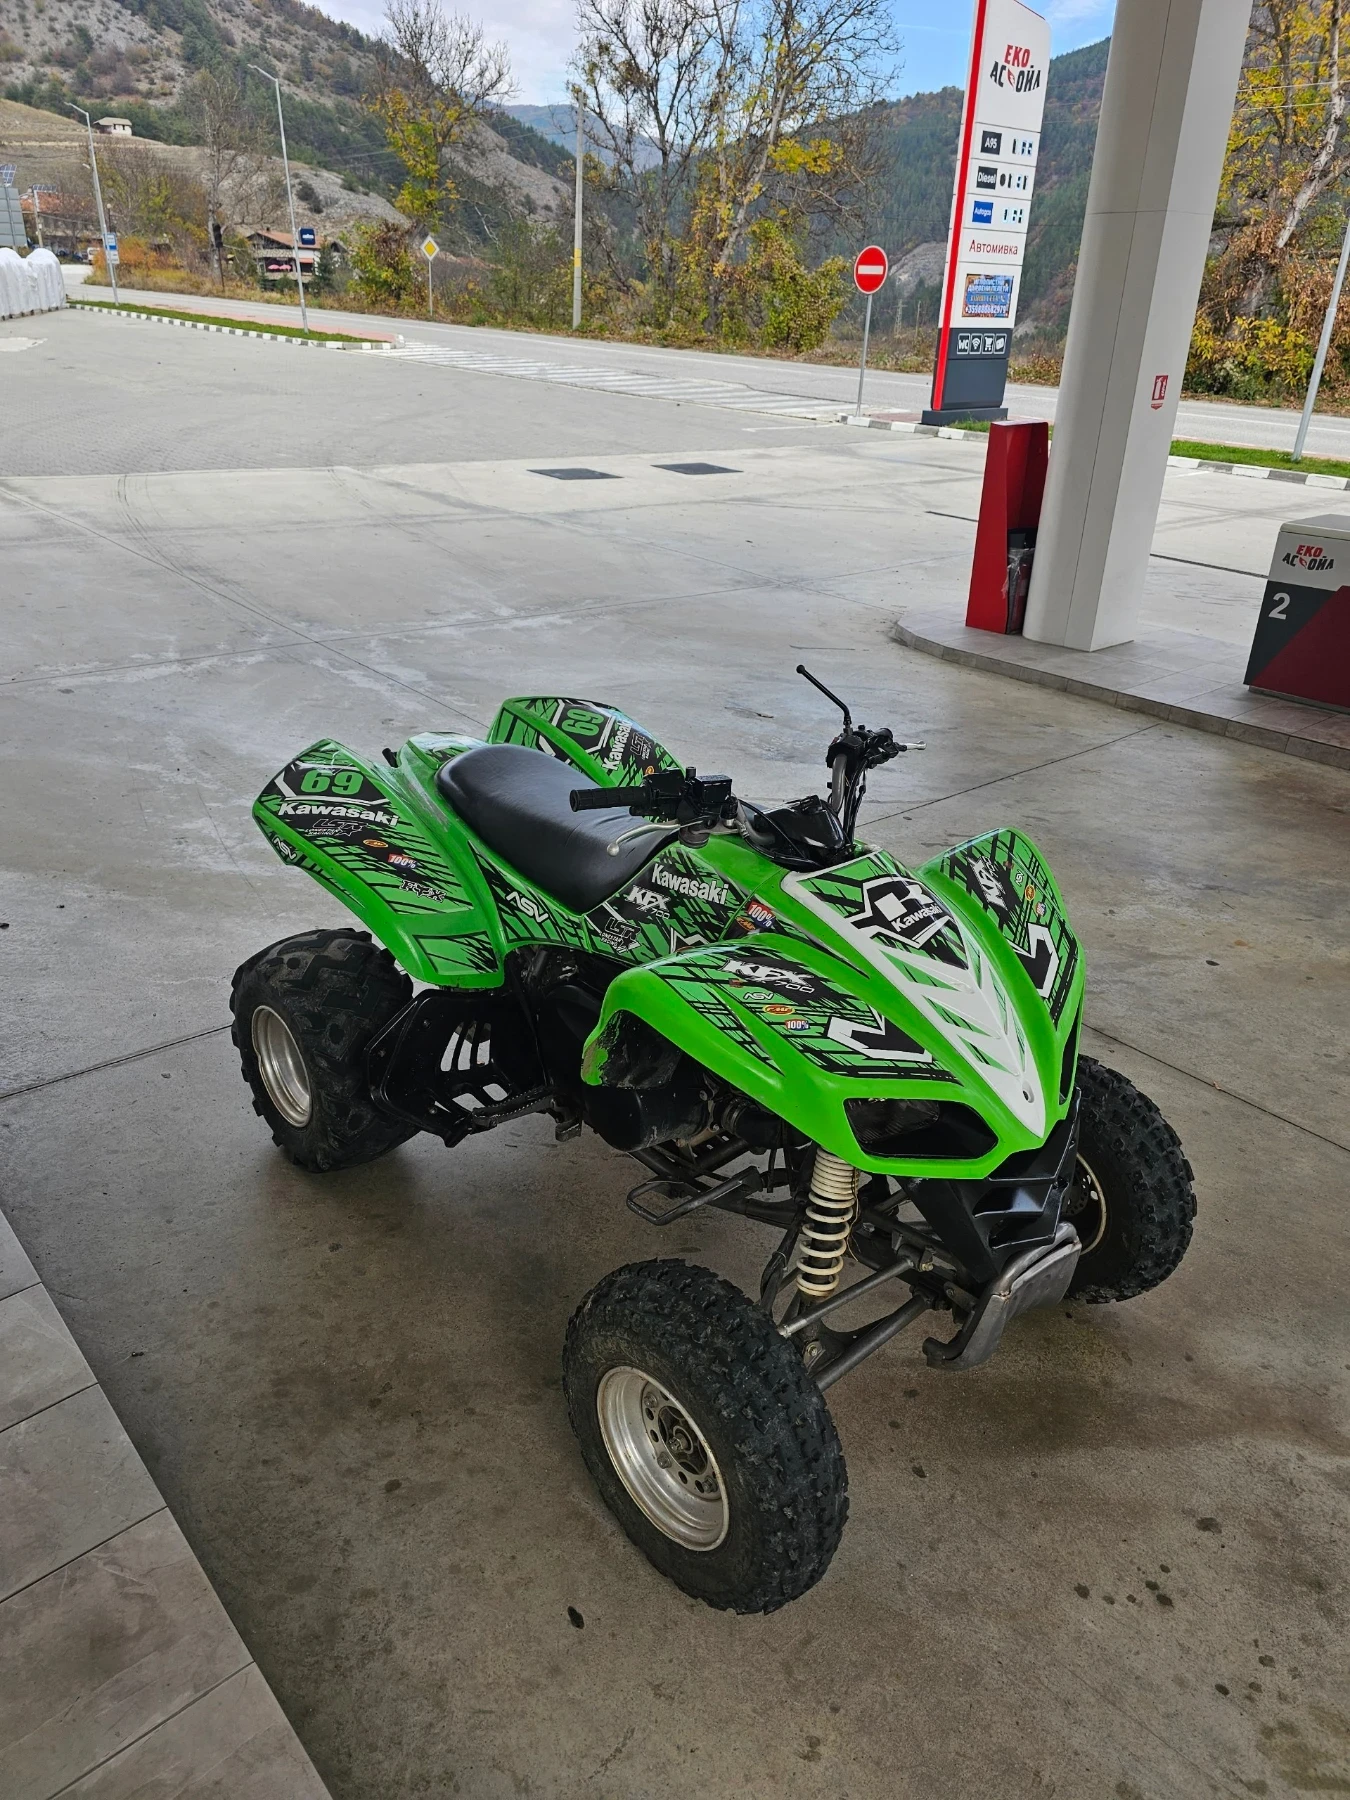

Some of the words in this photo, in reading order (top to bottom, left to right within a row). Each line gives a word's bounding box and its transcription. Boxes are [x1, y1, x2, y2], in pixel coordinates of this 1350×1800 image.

[977, 171, 997, 183] Diesel
[969, 239, 1018, 255] Автомивка
[1296, 544, 1324, 558] ЕКО
[1268, 592, 1291, 620] 2
[601, 719, 633, 771] Kawasak
[300, 769, 364, 795] 69
[278, 802, 399, 827] Kawasaki
[390, 855, 417, 869] 100%
[651, 863, 731, 905] Kawasaki
[624, 884, 672, 912] KFX
[748, 904, 776, 928] 100%
[890, 902, 943, 932] Kawasaki
[721, 958, 815, 988] KFX
[786, 1020, 810, 1030] 100%
